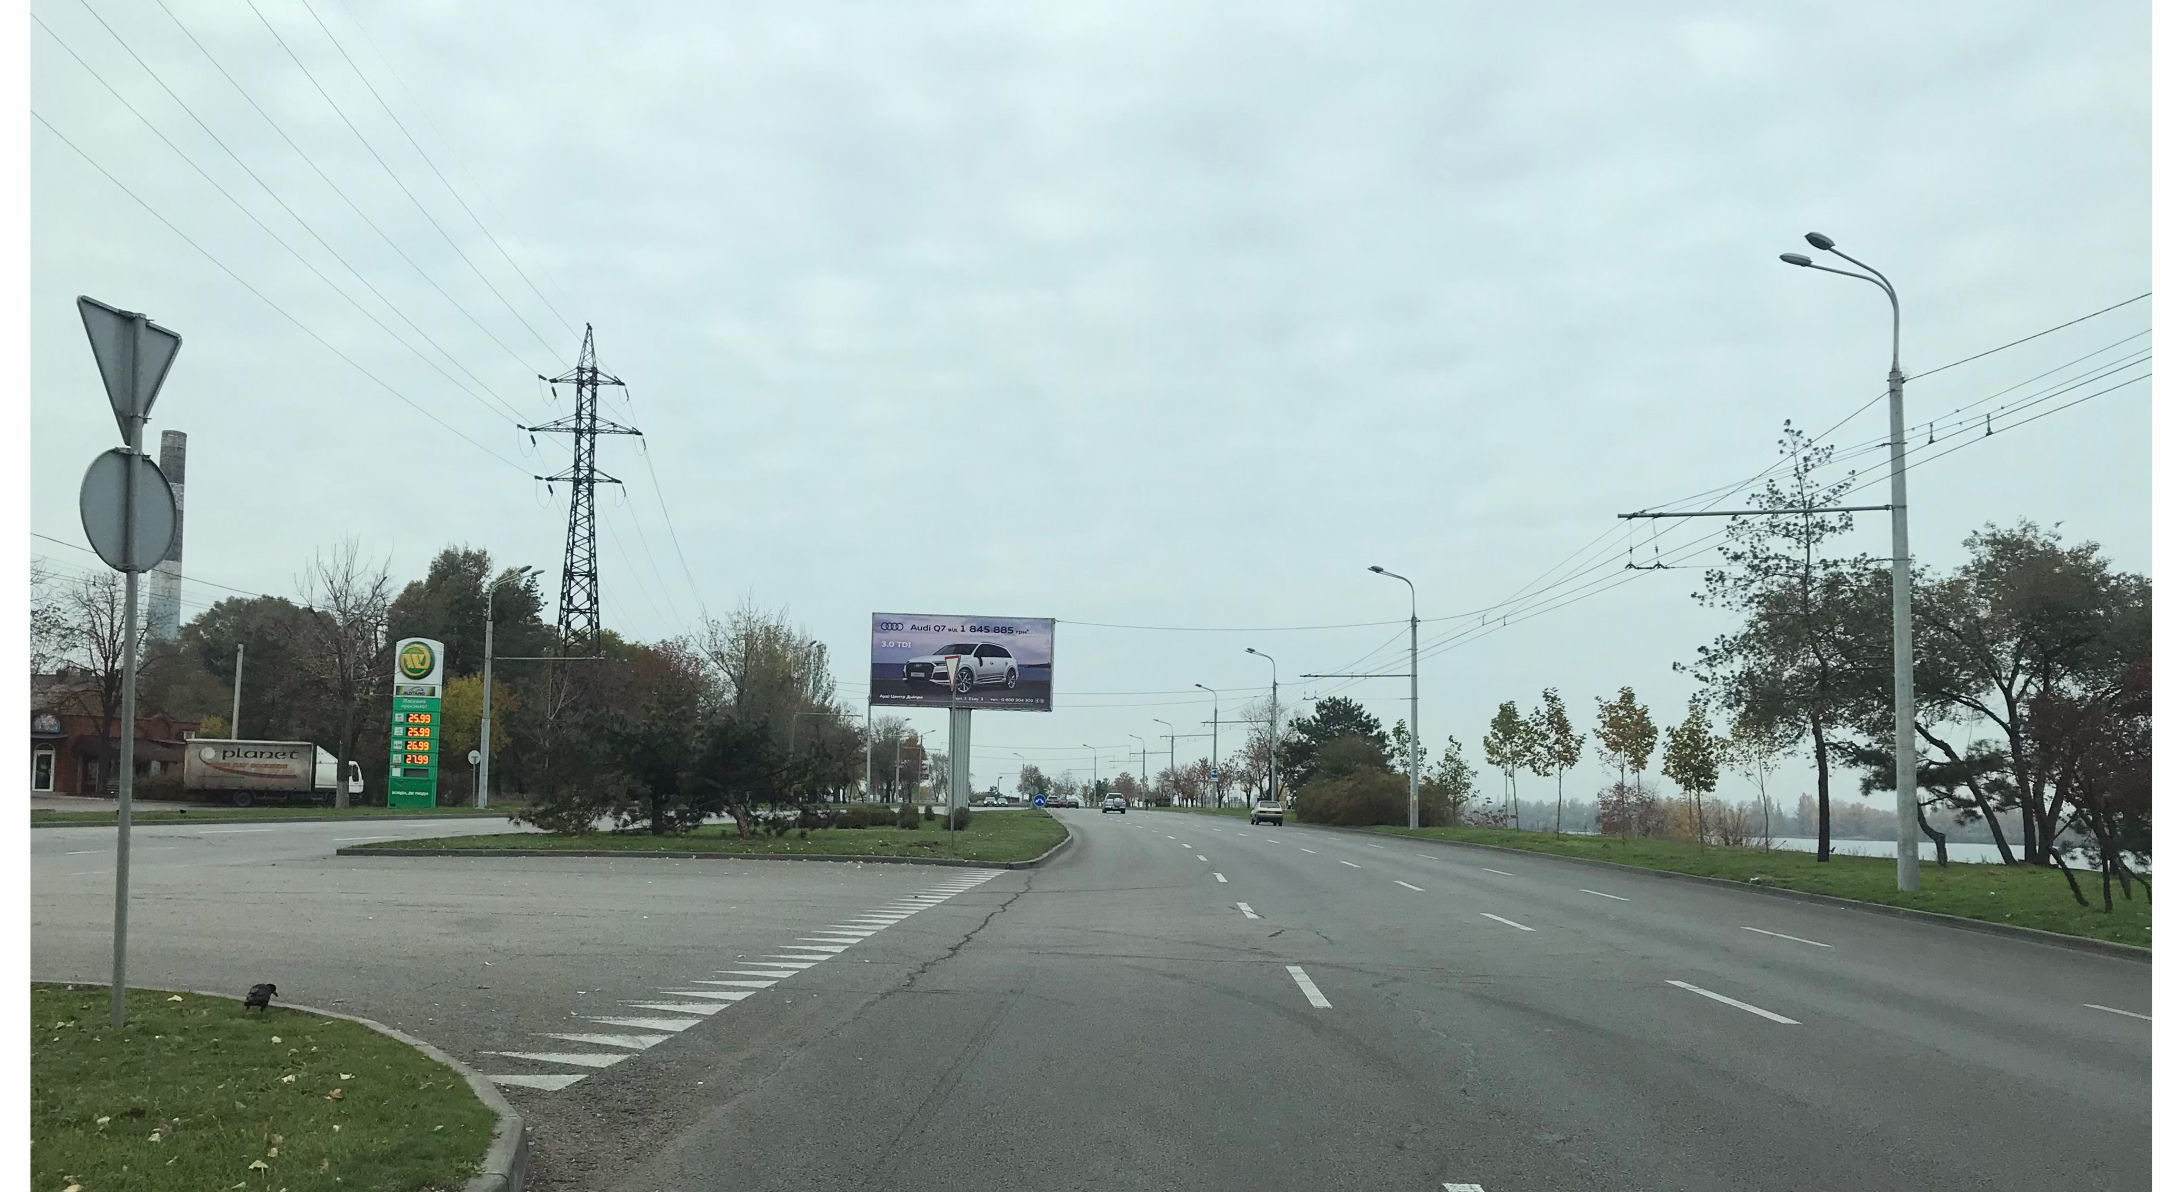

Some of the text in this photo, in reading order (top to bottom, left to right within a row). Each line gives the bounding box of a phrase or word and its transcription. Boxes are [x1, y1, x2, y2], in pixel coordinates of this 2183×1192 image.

[910, 624, 931, 632] Audi
[933, 625, 946, 633] Q7
[969, 625, 990, 633] 845
[993, 626, 1014, 634] 885
[881, 640, 895, 648] 3.0
[408, 713, 431, 723] 25.99
[407, 727, 430, 737] 25.99
[406, 741, 430, 750] 26.99
[222, 747, 299, 760] planet
[405, 754, 429, 764] 27.99
